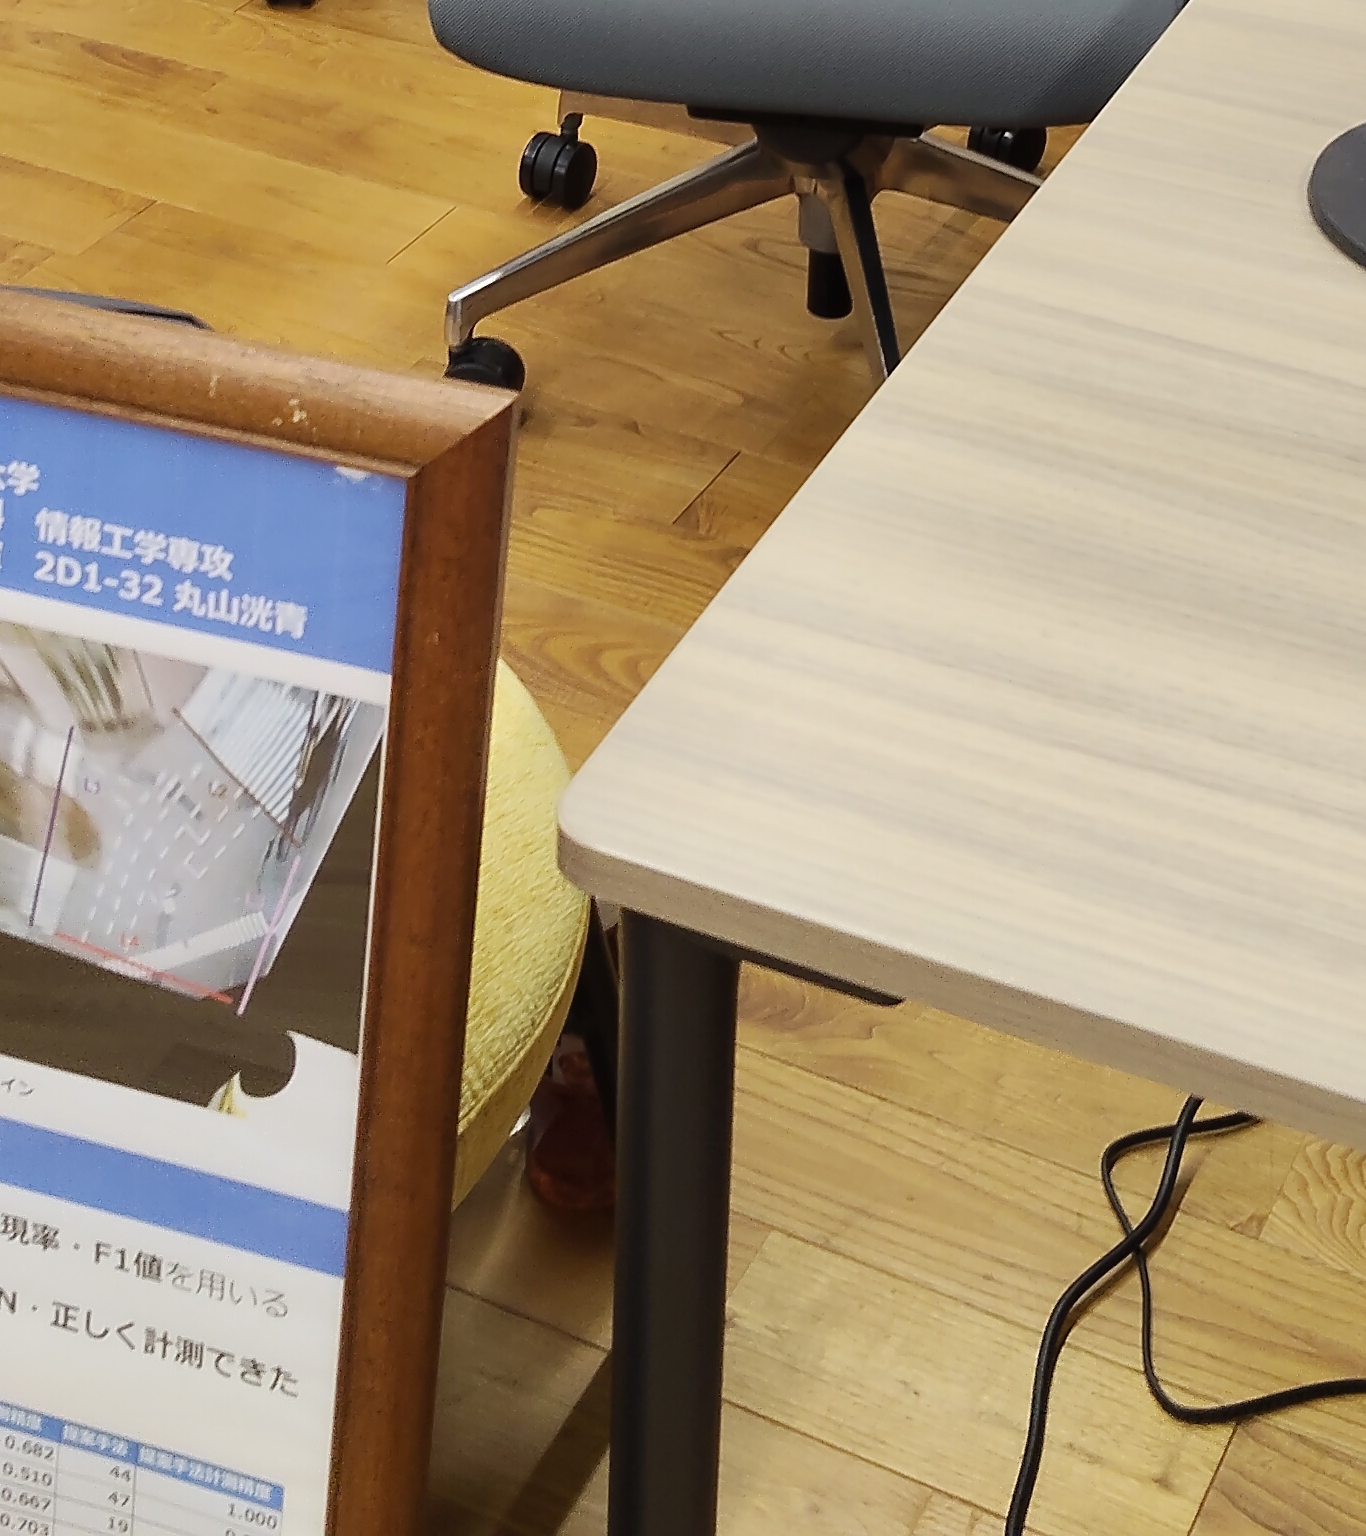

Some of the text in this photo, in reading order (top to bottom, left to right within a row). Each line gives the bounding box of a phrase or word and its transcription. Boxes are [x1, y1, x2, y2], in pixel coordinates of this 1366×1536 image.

[35, 507, 234, 581] 情報工学専攻
[33, 549, 163, 610] 2D1-32
[227, 1502, 278, 1530] 1.000
